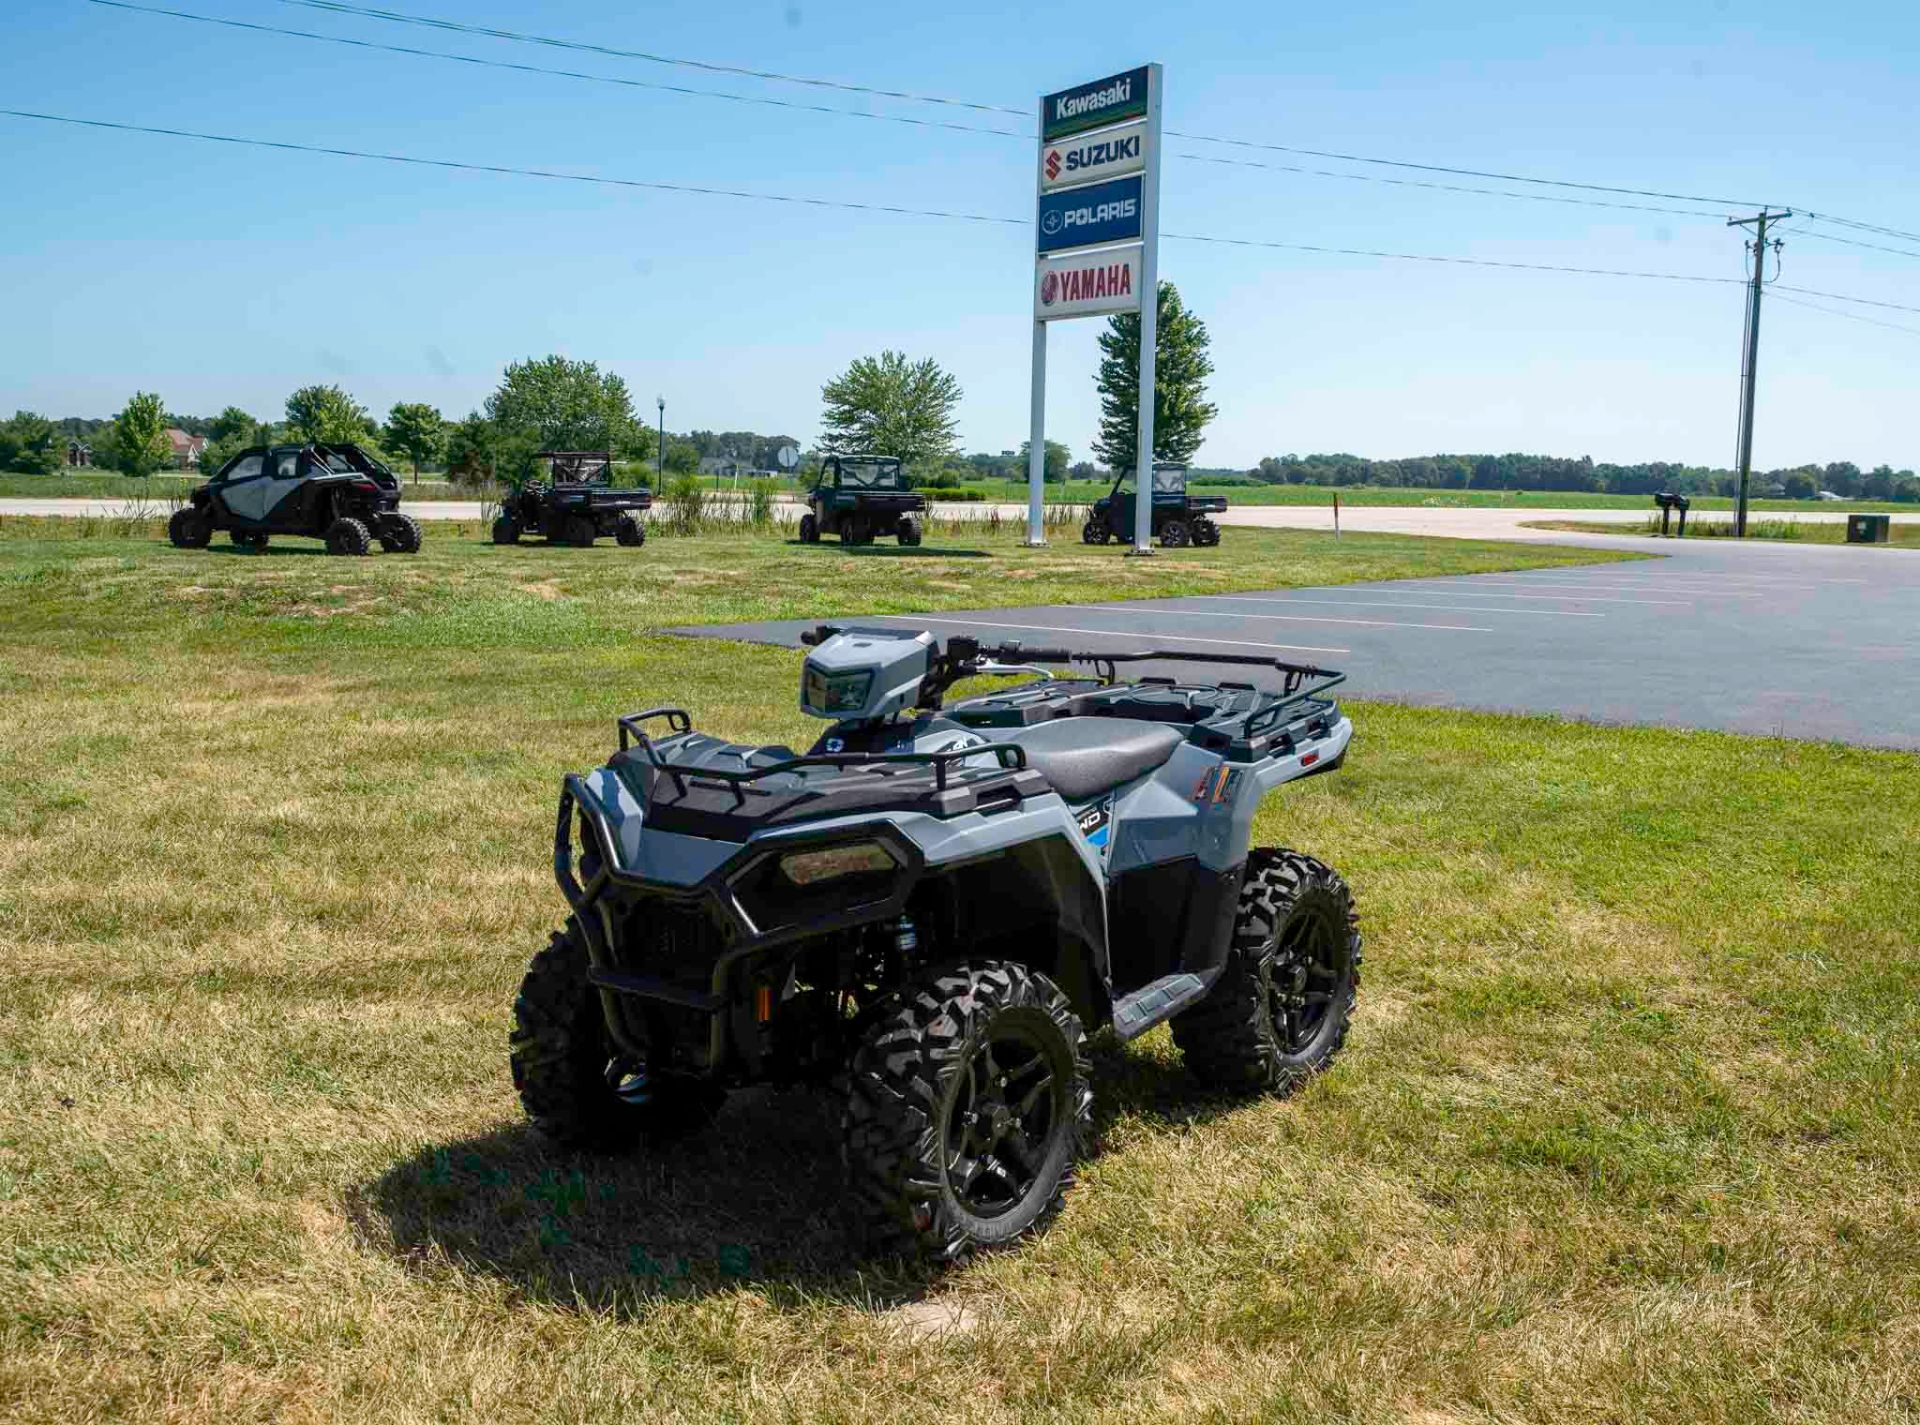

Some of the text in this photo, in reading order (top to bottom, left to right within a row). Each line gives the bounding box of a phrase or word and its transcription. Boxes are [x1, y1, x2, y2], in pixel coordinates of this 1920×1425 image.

[1056, 78, 1131, 120] Kawasaki
[1066, 135, 1140, 171] SUZUKI
[1064, 199, 1136, 229] POLARIS
[1060, 263, 1131, 302] YAMAHA
